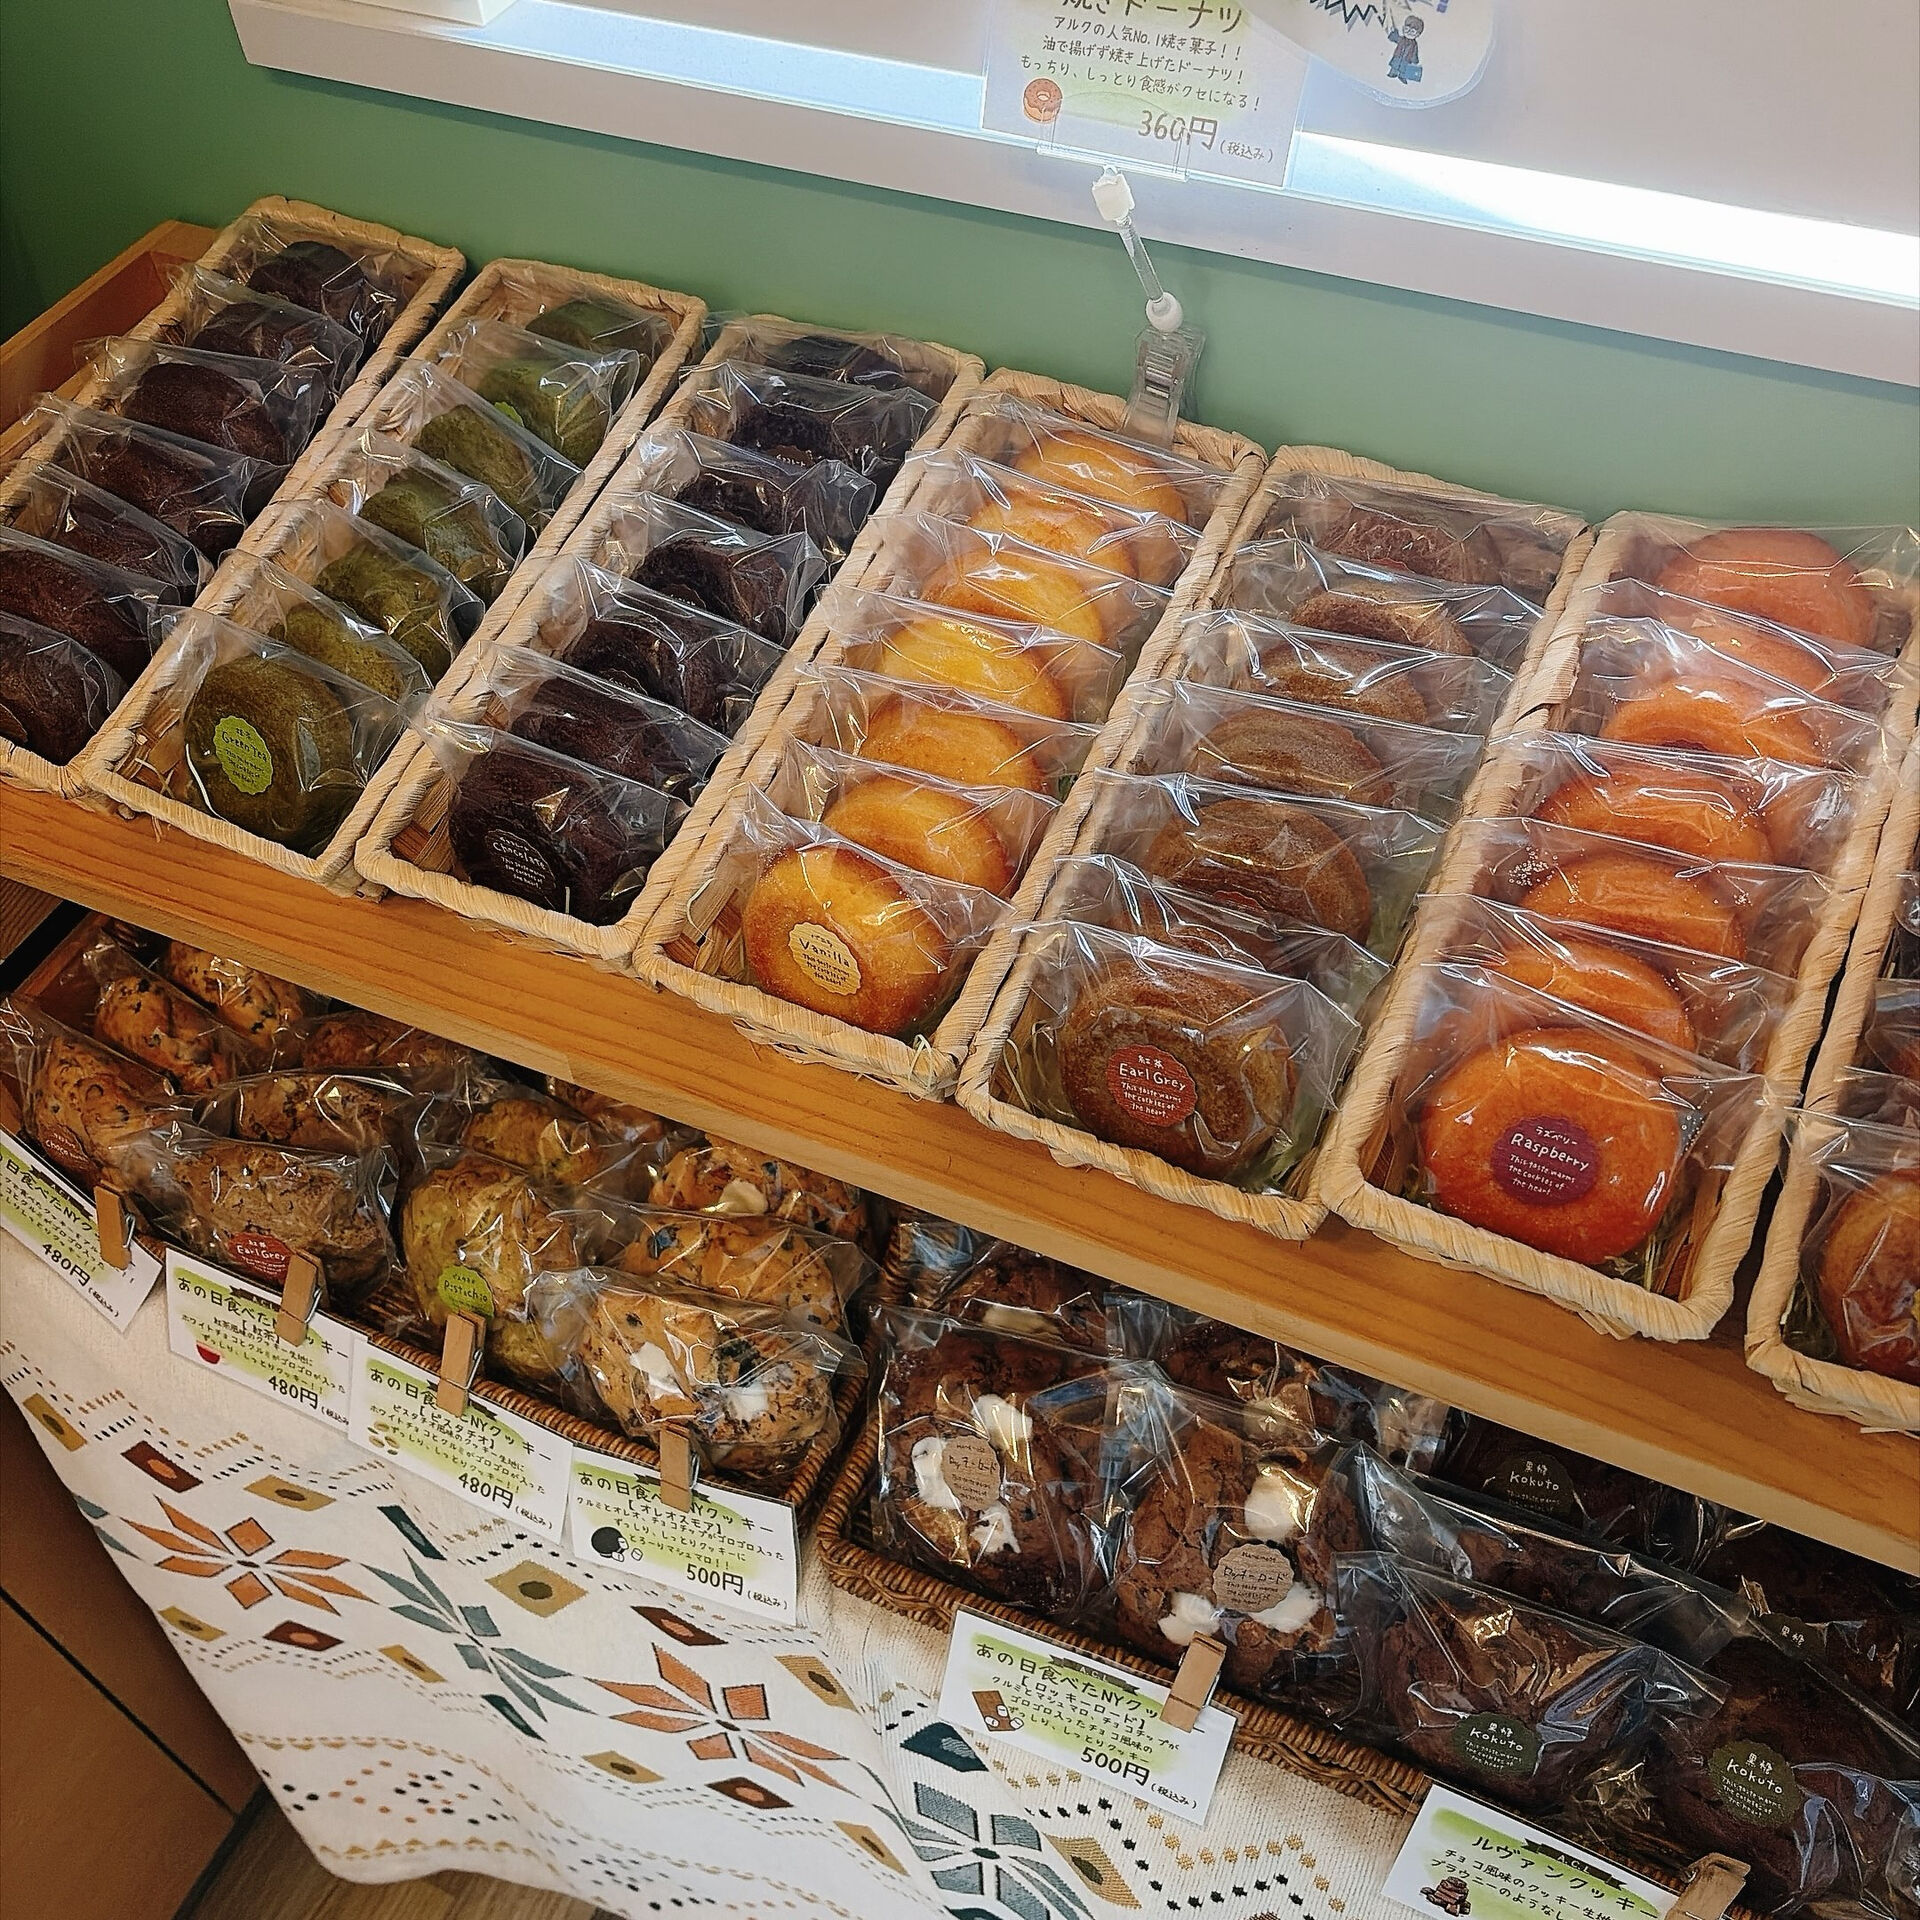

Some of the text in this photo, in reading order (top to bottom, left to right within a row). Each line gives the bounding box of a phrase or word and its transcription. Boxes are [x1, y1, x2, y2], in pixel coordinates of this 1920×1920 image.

[1138, 110, 1218, 151] 360円
[799, 938, 850, 967] Vanilla
[1119, 1062, 1186, 1091] Earl Grey
[1510, 1133, 1589, 1171] Raspberry
[1536, 1126, 1578, 1145] ラズベリー
[42, 1242, 91, 1287] 480円
[237, 1244, 286, 1261] Earl Grey
[268, 1375, 318, 1410] 480円
[458, 1472, 514, 1510] 480円
[686, 1563, 744, 1597] 500円
[1470, 1727, 1523, 1751] Kokuto
[1080, 1746, 1150, 1786] 500円
[1726, 1758, 1783, 1794] Kokuto
[1556, 1853, 1590, 1874] A.C.L
